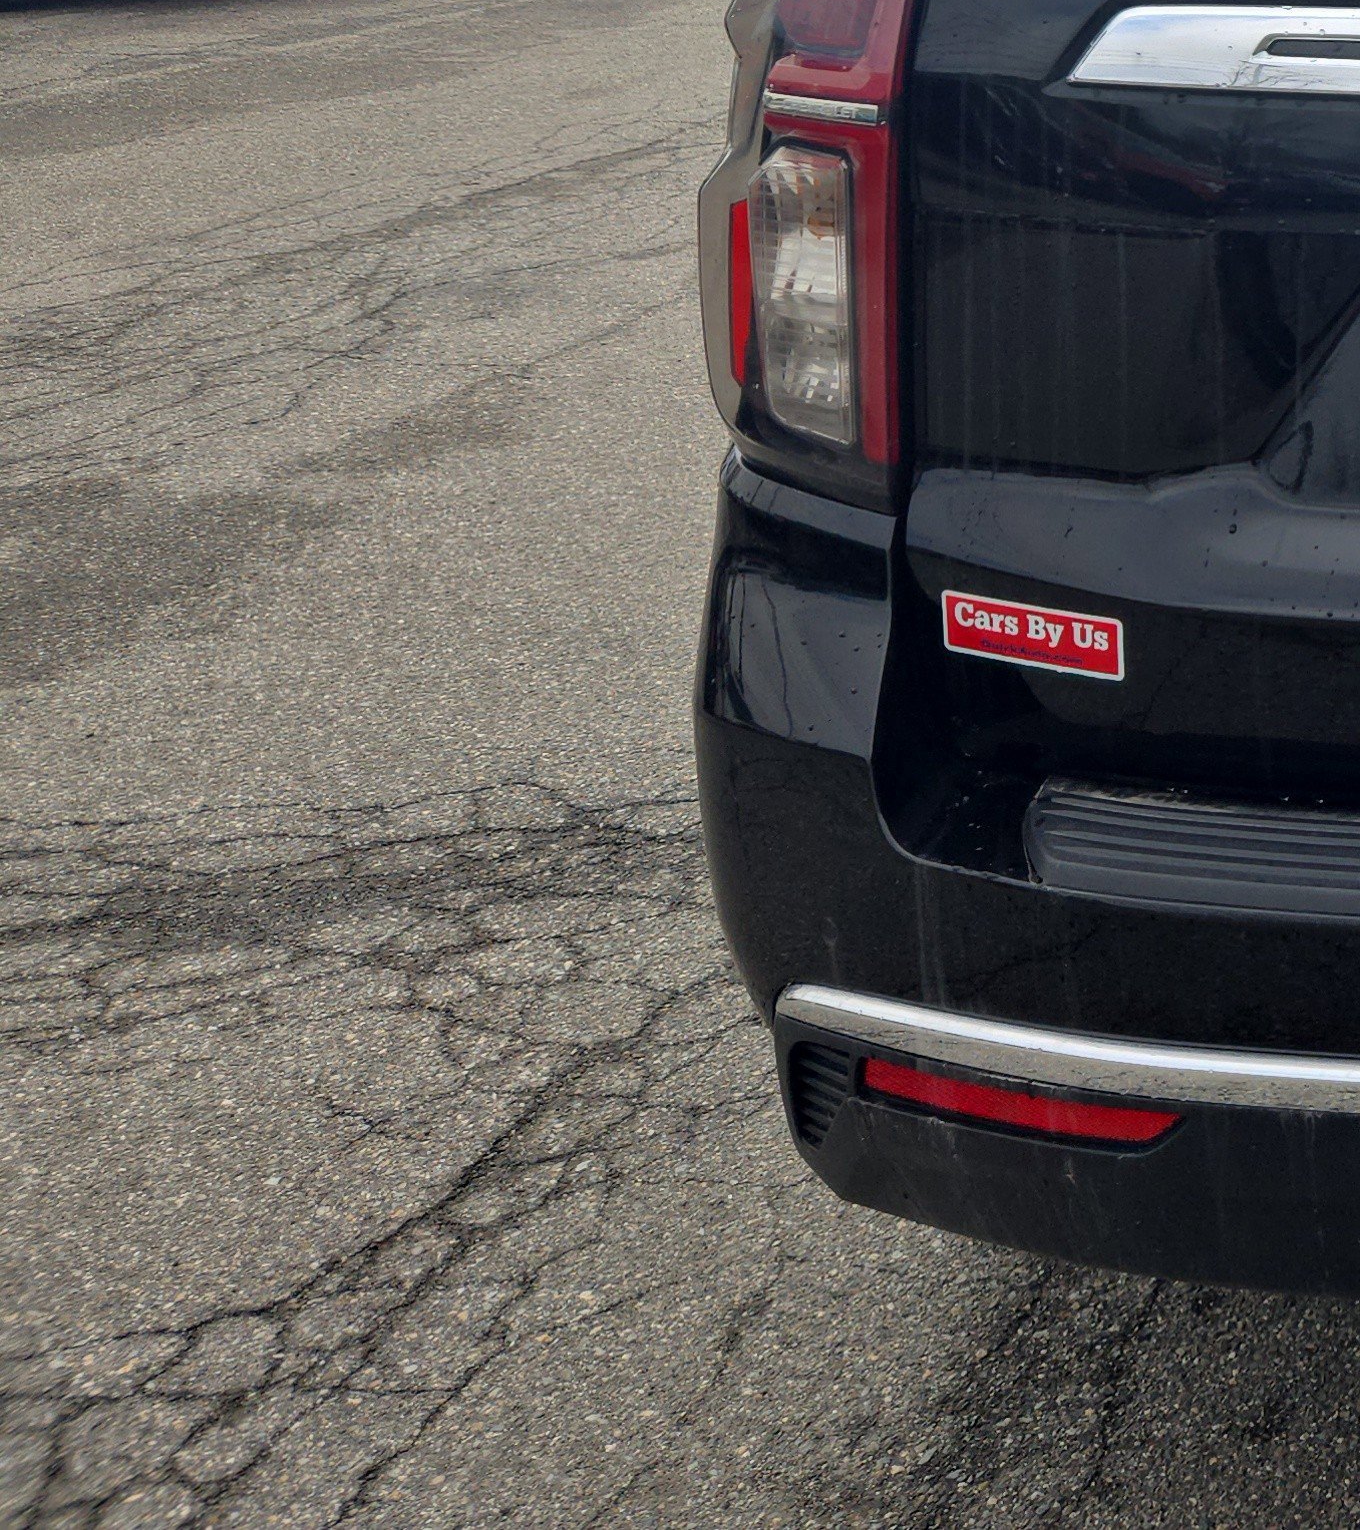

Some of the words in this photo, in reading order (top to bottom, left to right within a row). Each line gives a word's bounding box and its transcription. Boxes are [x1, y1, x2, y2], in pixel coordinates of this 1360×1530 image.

[954, 601, 1019, 637] Cars
[1026, 613, 1064, 648] By
[1071, 622, 1109, 652] Us
